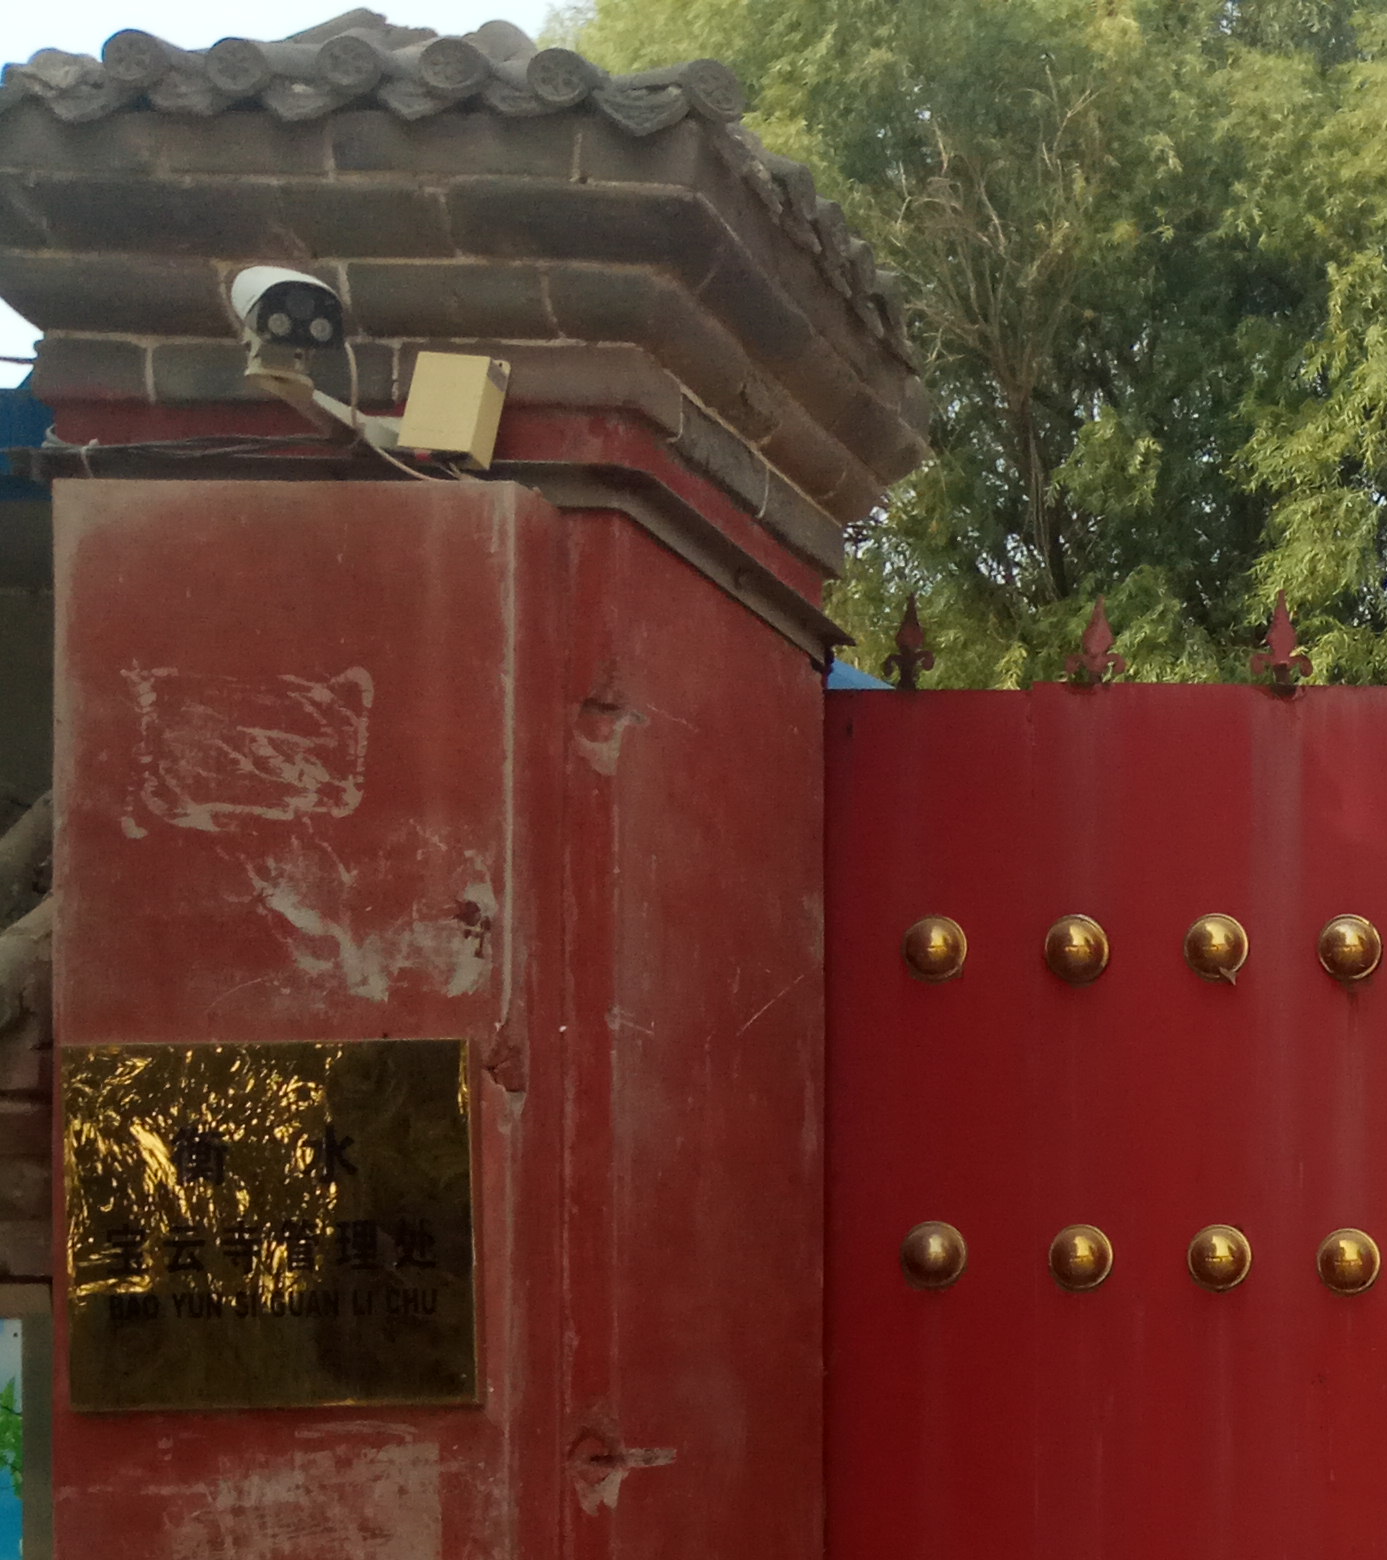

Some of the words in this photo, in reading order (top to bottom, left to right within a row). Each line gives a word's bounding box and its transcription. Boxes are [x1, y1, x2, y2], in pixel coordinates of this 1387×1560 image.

[104, 1219, 437, 1276] 宝云寺管理处
[109, 1293, 160, 1322] BAO
[171, 1292, 223, 1320] YUN
[352, 1288, 375, 1316] LI
[386, 1286, 438, 1316] CHU
